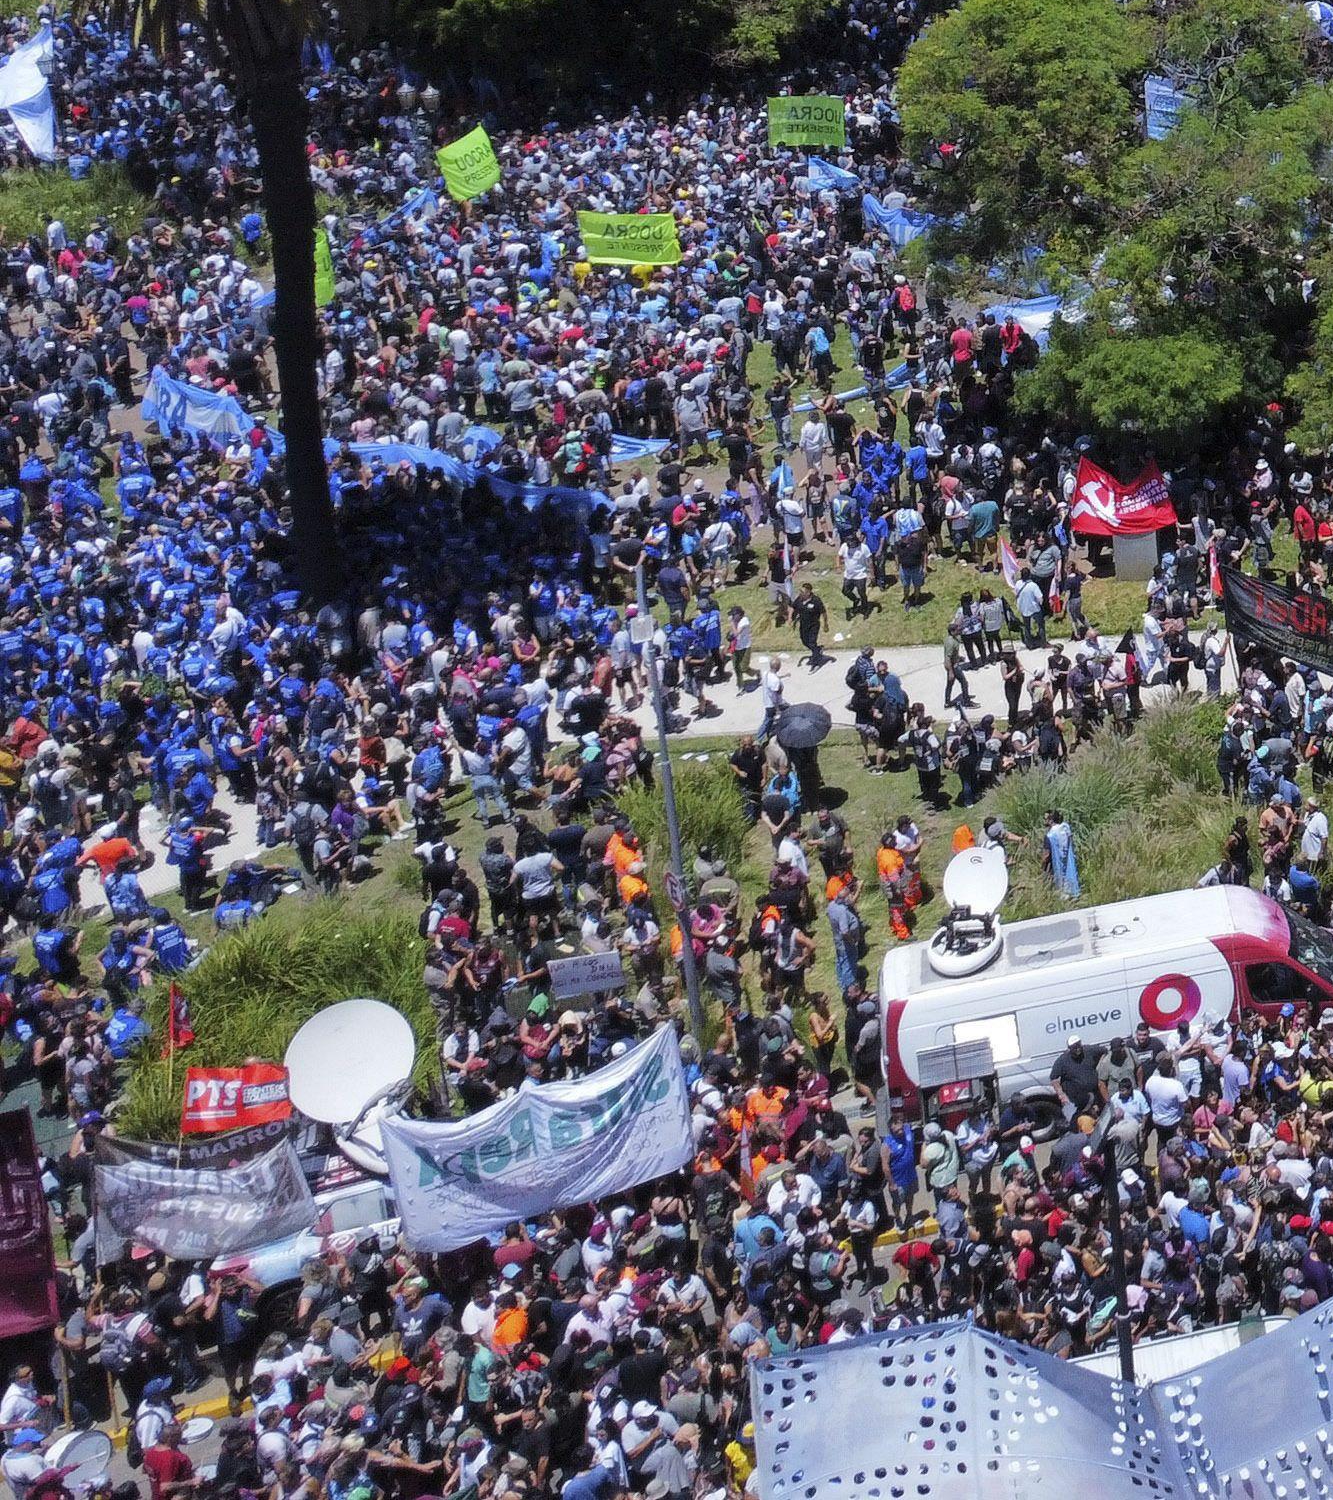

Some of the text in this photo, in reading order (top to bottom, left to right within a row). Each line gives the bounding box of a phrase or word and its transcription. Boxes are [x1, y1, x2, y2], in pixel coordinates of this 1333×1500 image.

[455, 142, 491, 172] UOCRA
[1044, 1006, 1123, 1035] elnueve
[187, 1078, 243, 1108] PTS
